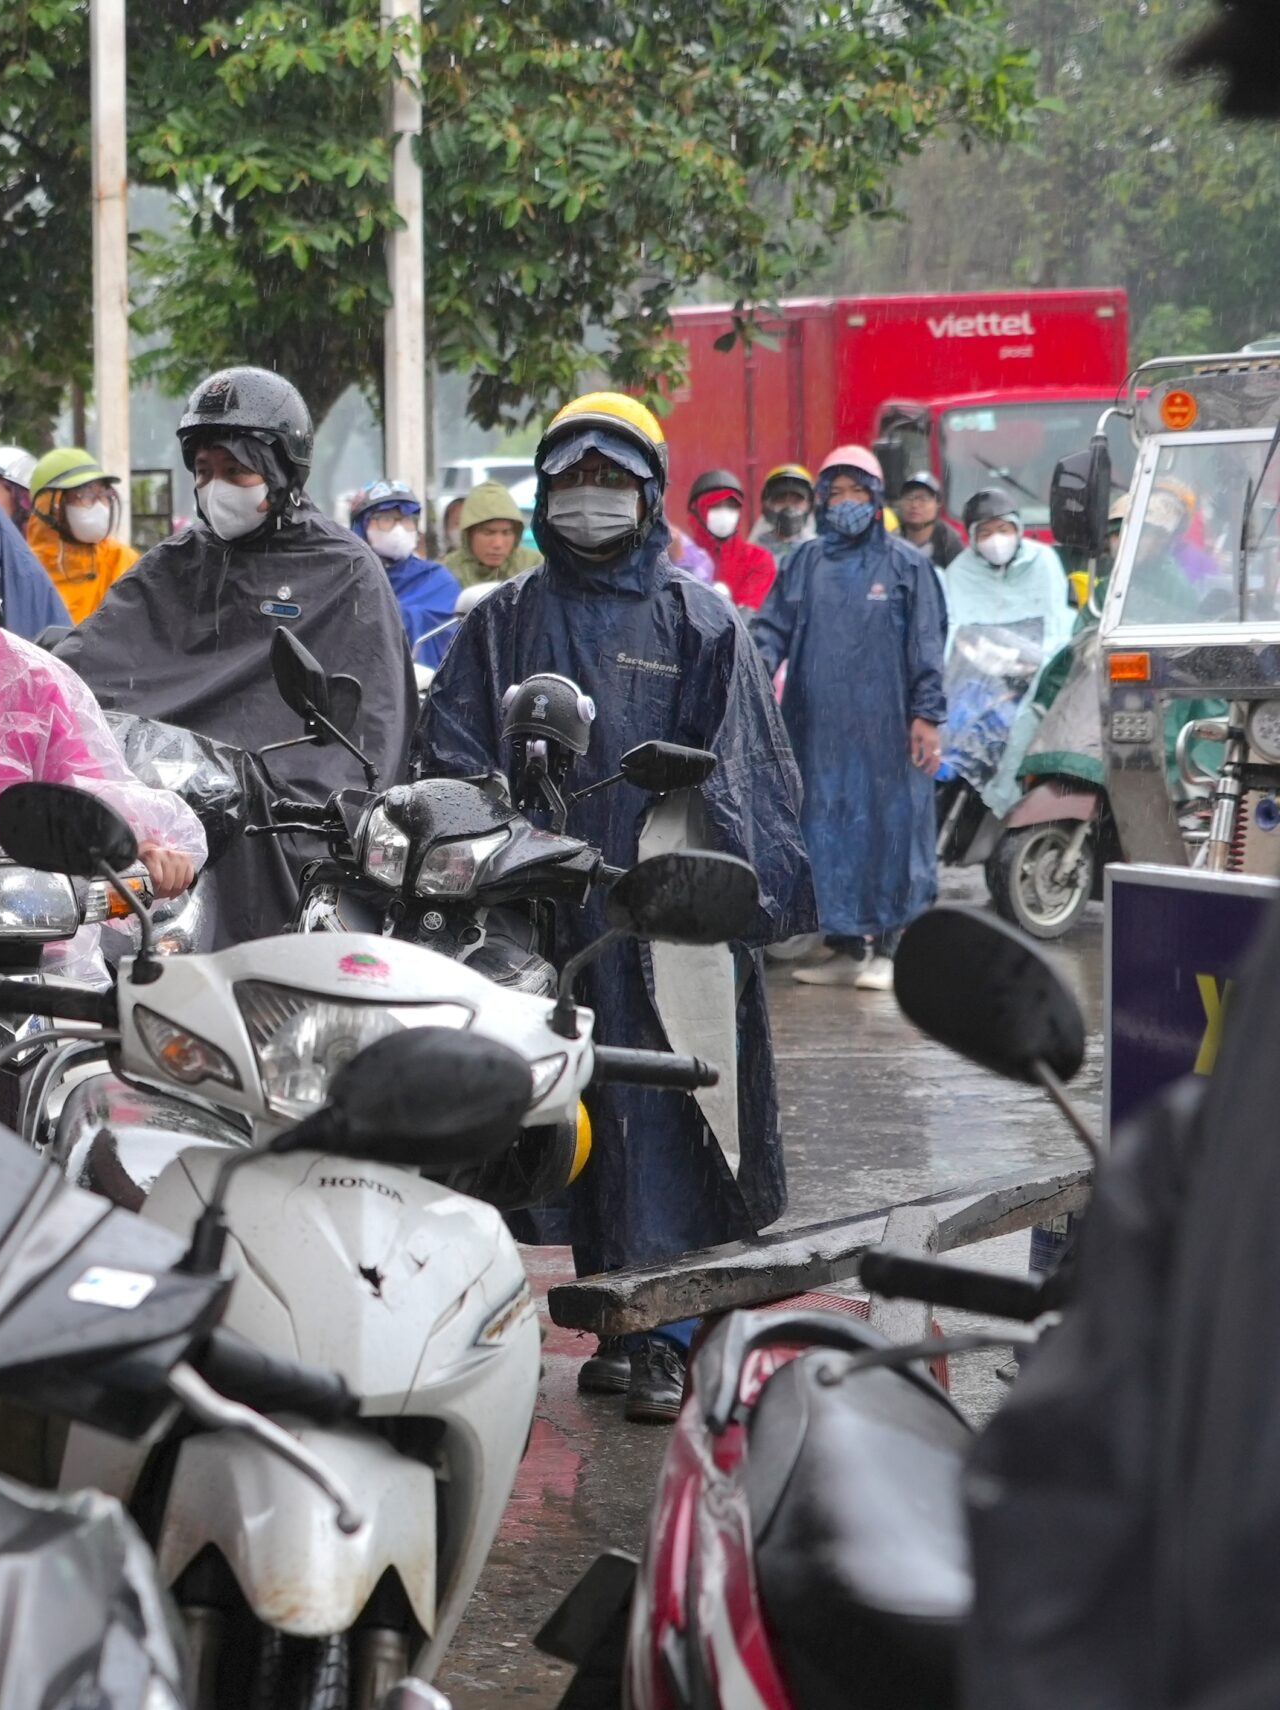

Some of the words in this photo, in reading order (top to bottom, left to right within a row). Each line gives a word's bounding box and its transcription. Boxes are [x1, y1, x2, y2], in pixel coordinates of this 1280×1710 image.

[926, 311, 1036, 338] viettel
[616, 652, 680, 674] Sacombank
[319, 1177, 406, 1205] HONDA
